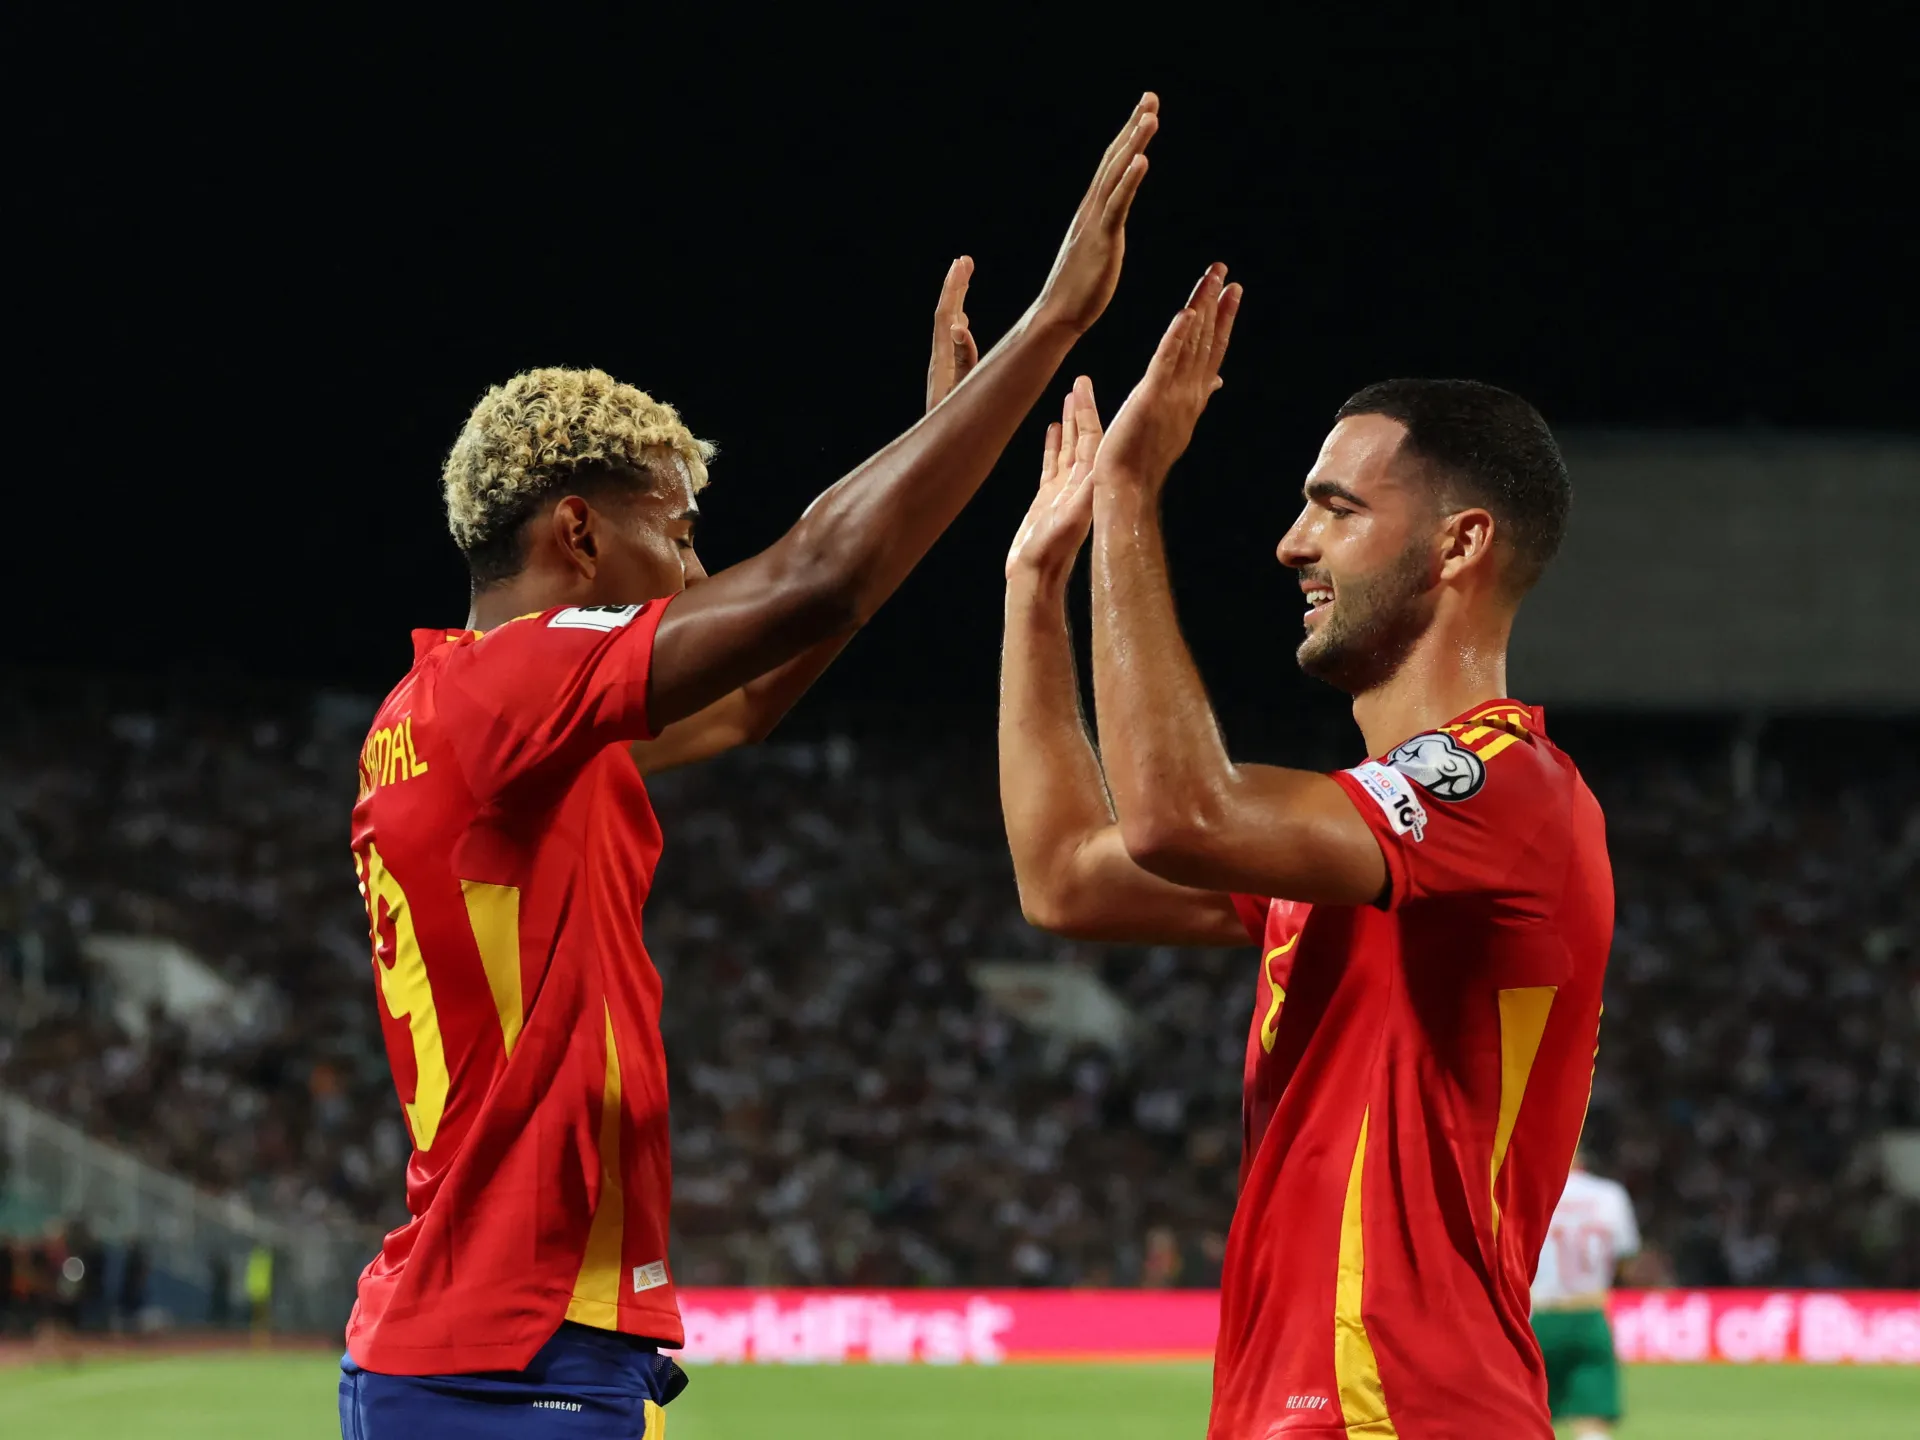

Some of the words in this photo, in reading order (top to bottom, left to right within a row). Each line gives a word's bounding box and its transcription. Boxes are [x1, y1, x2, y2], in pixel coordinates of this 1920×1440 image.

[1366, 768, 1397, 797] ATION
[1393, 794, 1415, 827] 10
[354, 842, 450, 1152] 9
[680, 1296, 1014, 1363] orldFirst
[1614, 1293, 1708, 1362] rld
[1716, 1294, 1790, 1362] of
[532, 1400, 583, 1413] AEROREADY
